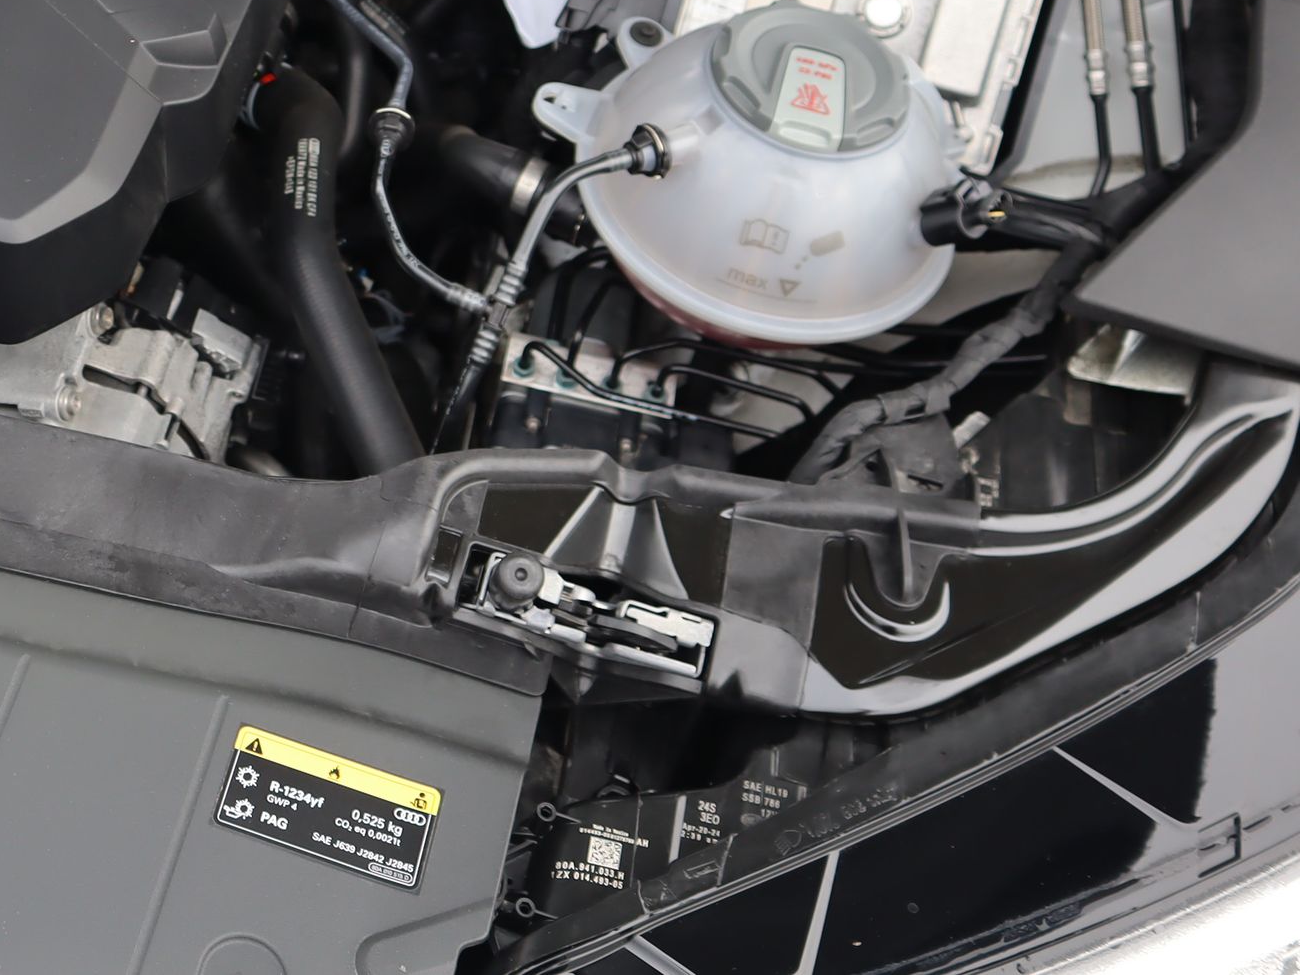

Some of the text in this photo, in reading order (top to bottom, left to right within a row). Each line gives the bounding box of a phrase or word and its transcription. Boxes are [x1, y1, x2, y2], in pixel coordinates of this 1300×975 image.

[727, 267, 767, 291] max
[269, 780, 325, 809] R-1234yf
[743, 780, 762, 793] SAE
[266, 794, 298, 812] GWP 4
[698, 800, 717, 813] 24S
[260, 811, 289, 830] PAG
[351, 809, 403, 837] 0,525 kg
[354, 825, 366, 837] eq
[312, 832, 332, 846] SAE
[333, 840, 356, 855] J639
[356, 847, 385, 865] J2842
